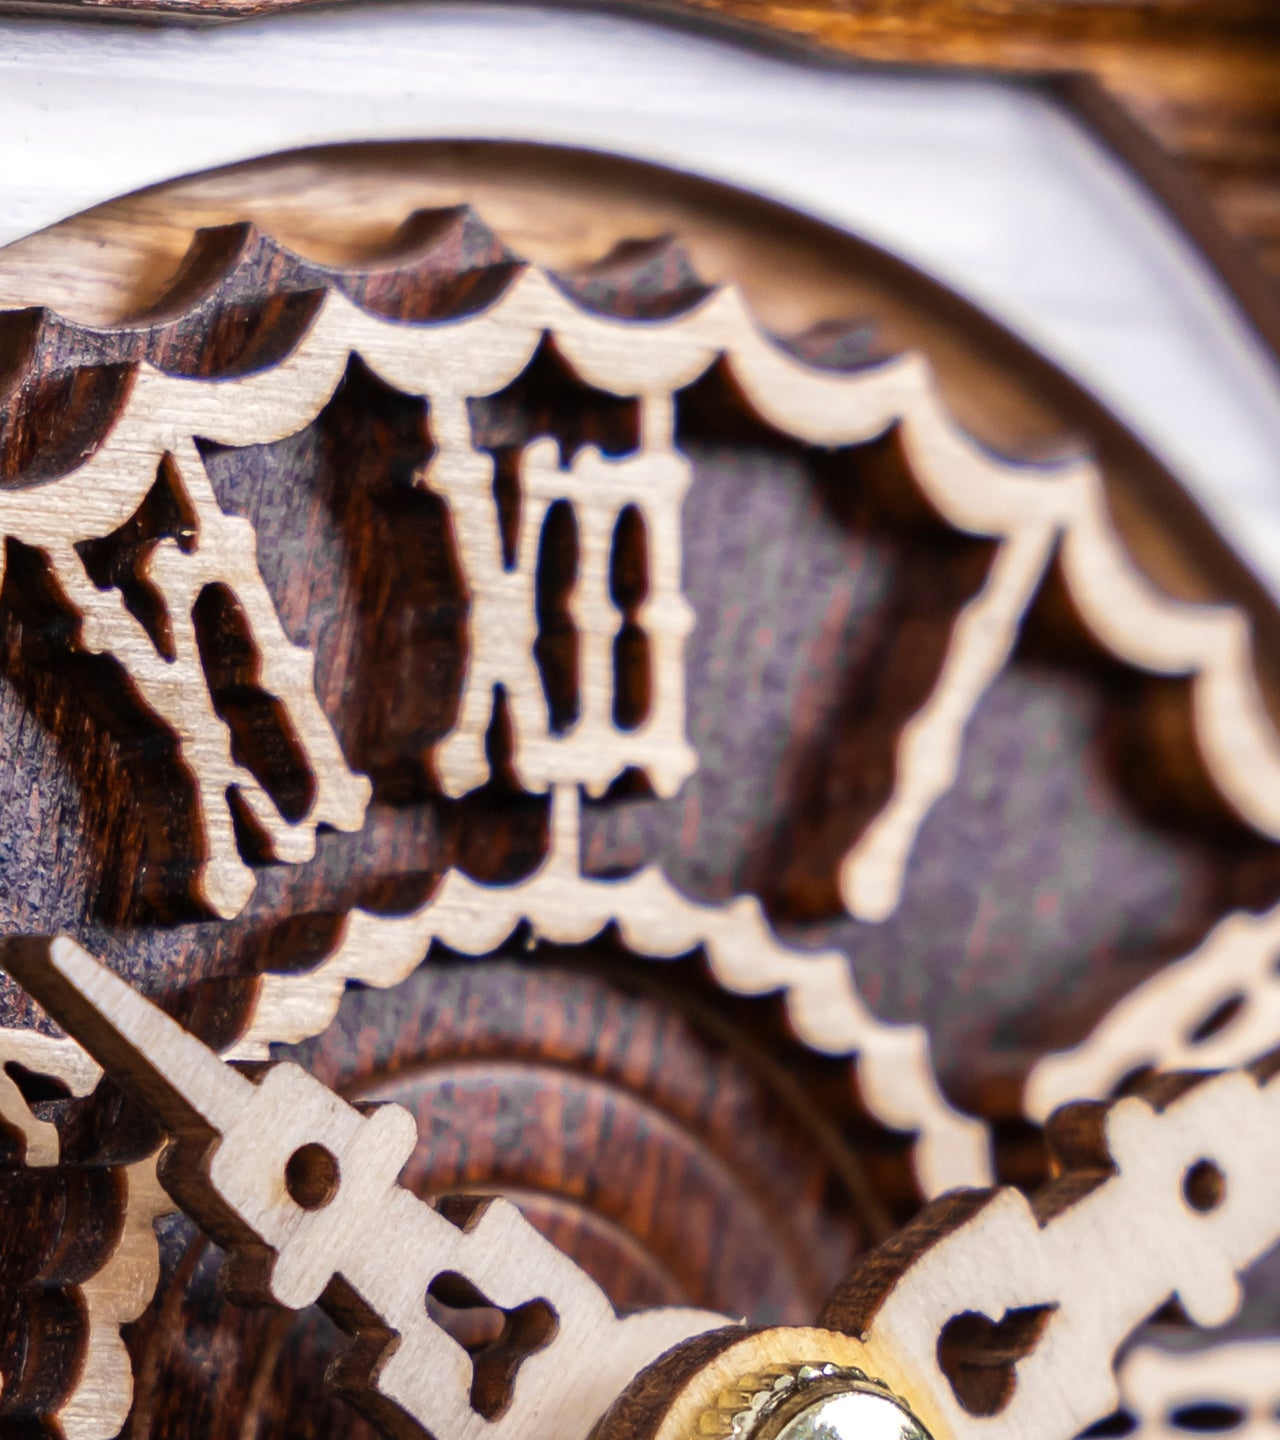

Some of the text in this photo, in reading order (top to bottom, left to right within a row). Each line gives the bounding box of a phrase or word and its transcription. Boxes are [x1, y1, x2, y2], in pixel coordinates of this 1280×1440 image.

[55, 505, 372, 920] XI
[427, 436, 696, 798] XII
[838, 528, 1058, 923] I
